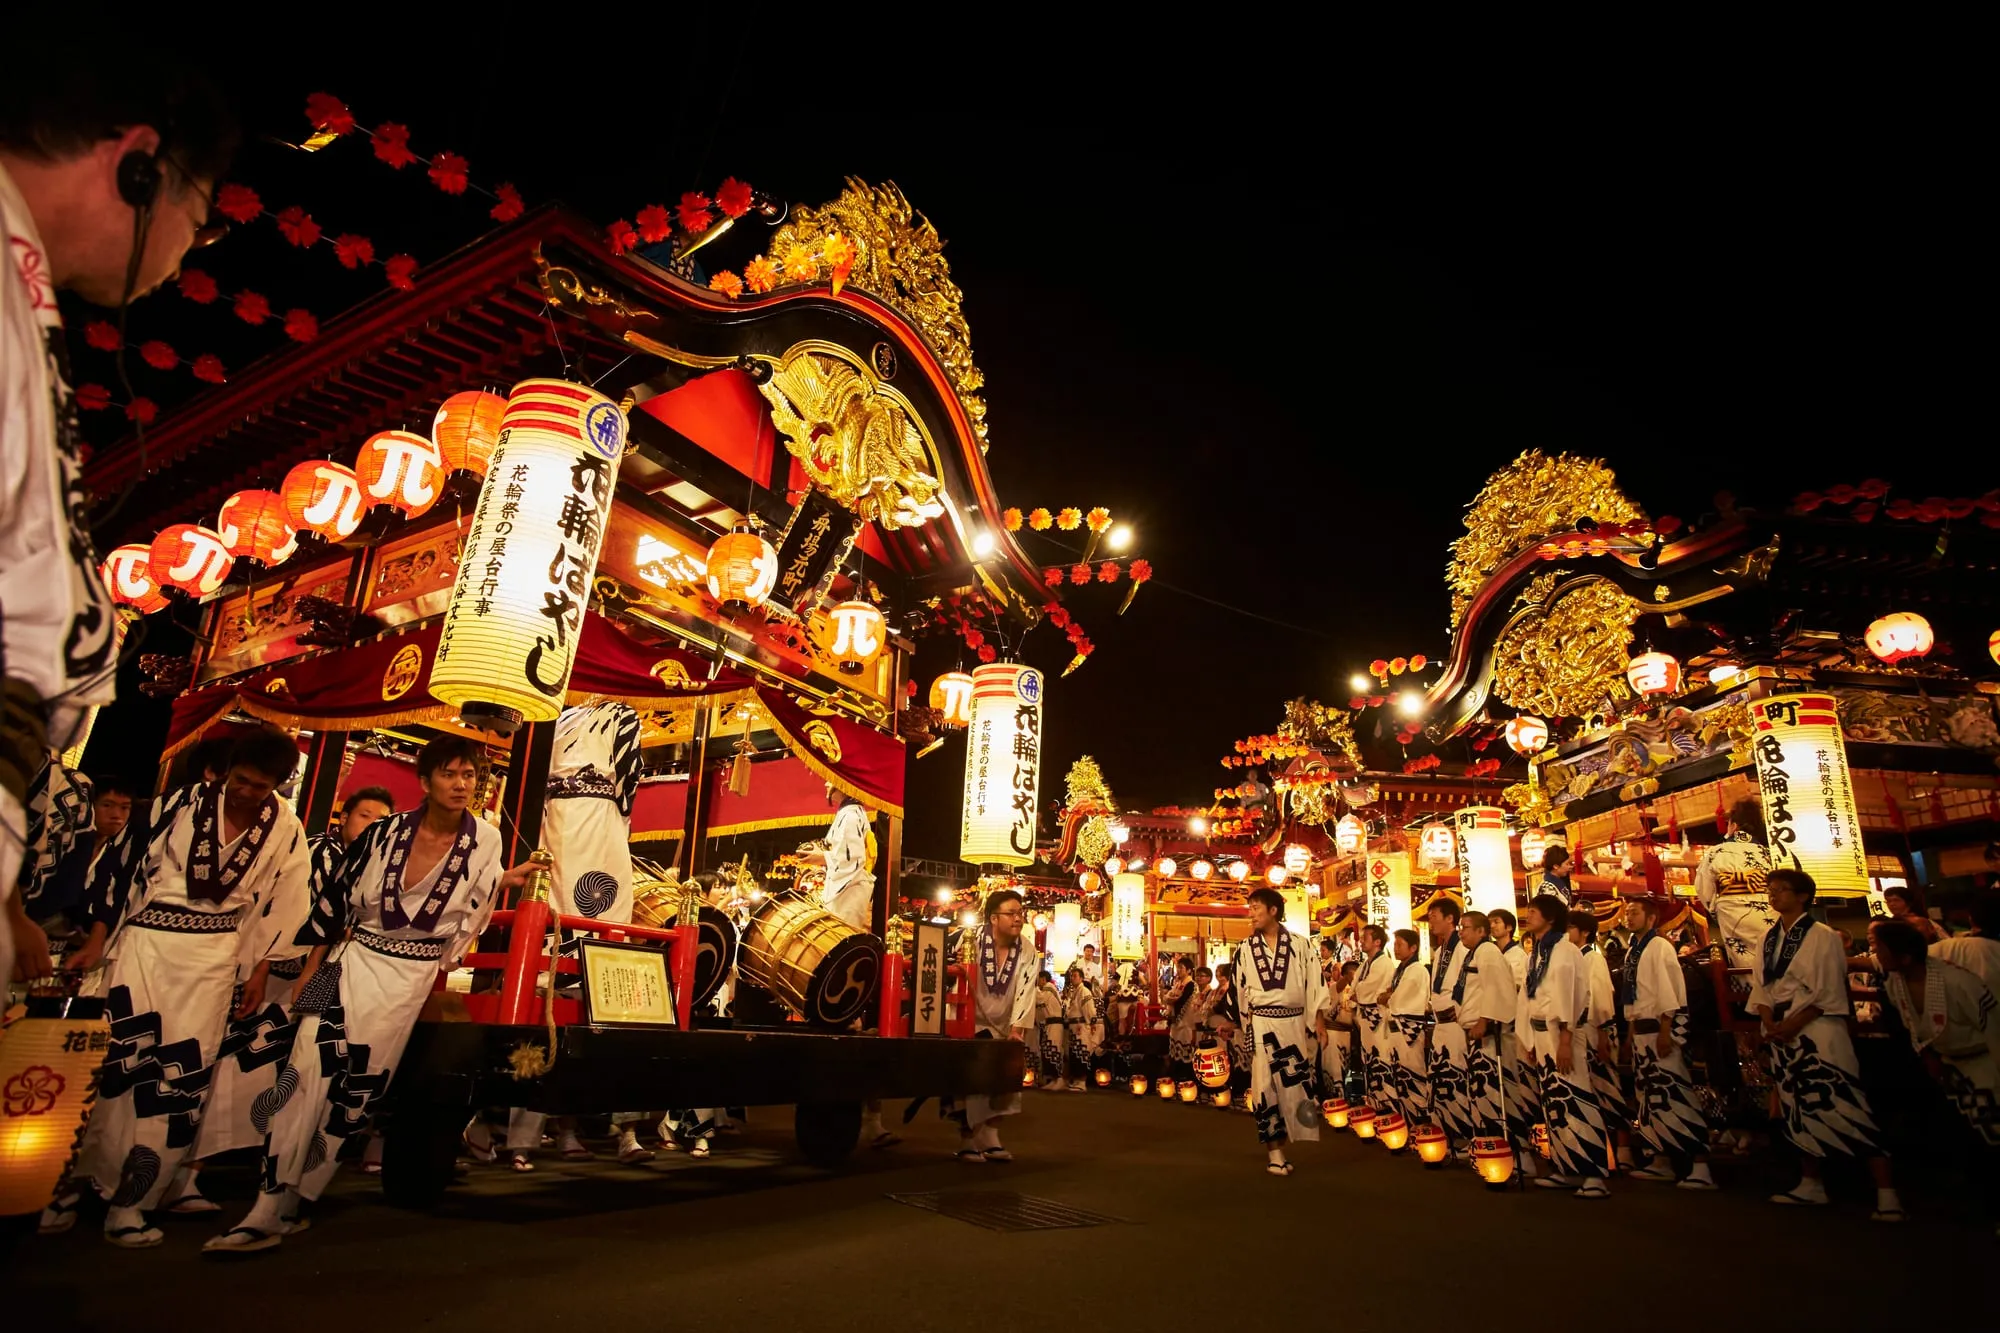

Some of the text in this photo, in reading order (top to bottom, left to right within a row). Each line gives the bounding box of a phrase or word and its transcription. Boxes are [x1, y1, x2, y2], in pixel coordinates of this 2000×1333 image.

[474, 464, 530, 617] 花輪祭の屋台行事
[1764, 701, 1801, 727] 町
[1460, 812, 1477, 829] 町
[1816, 749, 1843, 848] 花輪祭の屋台行事
